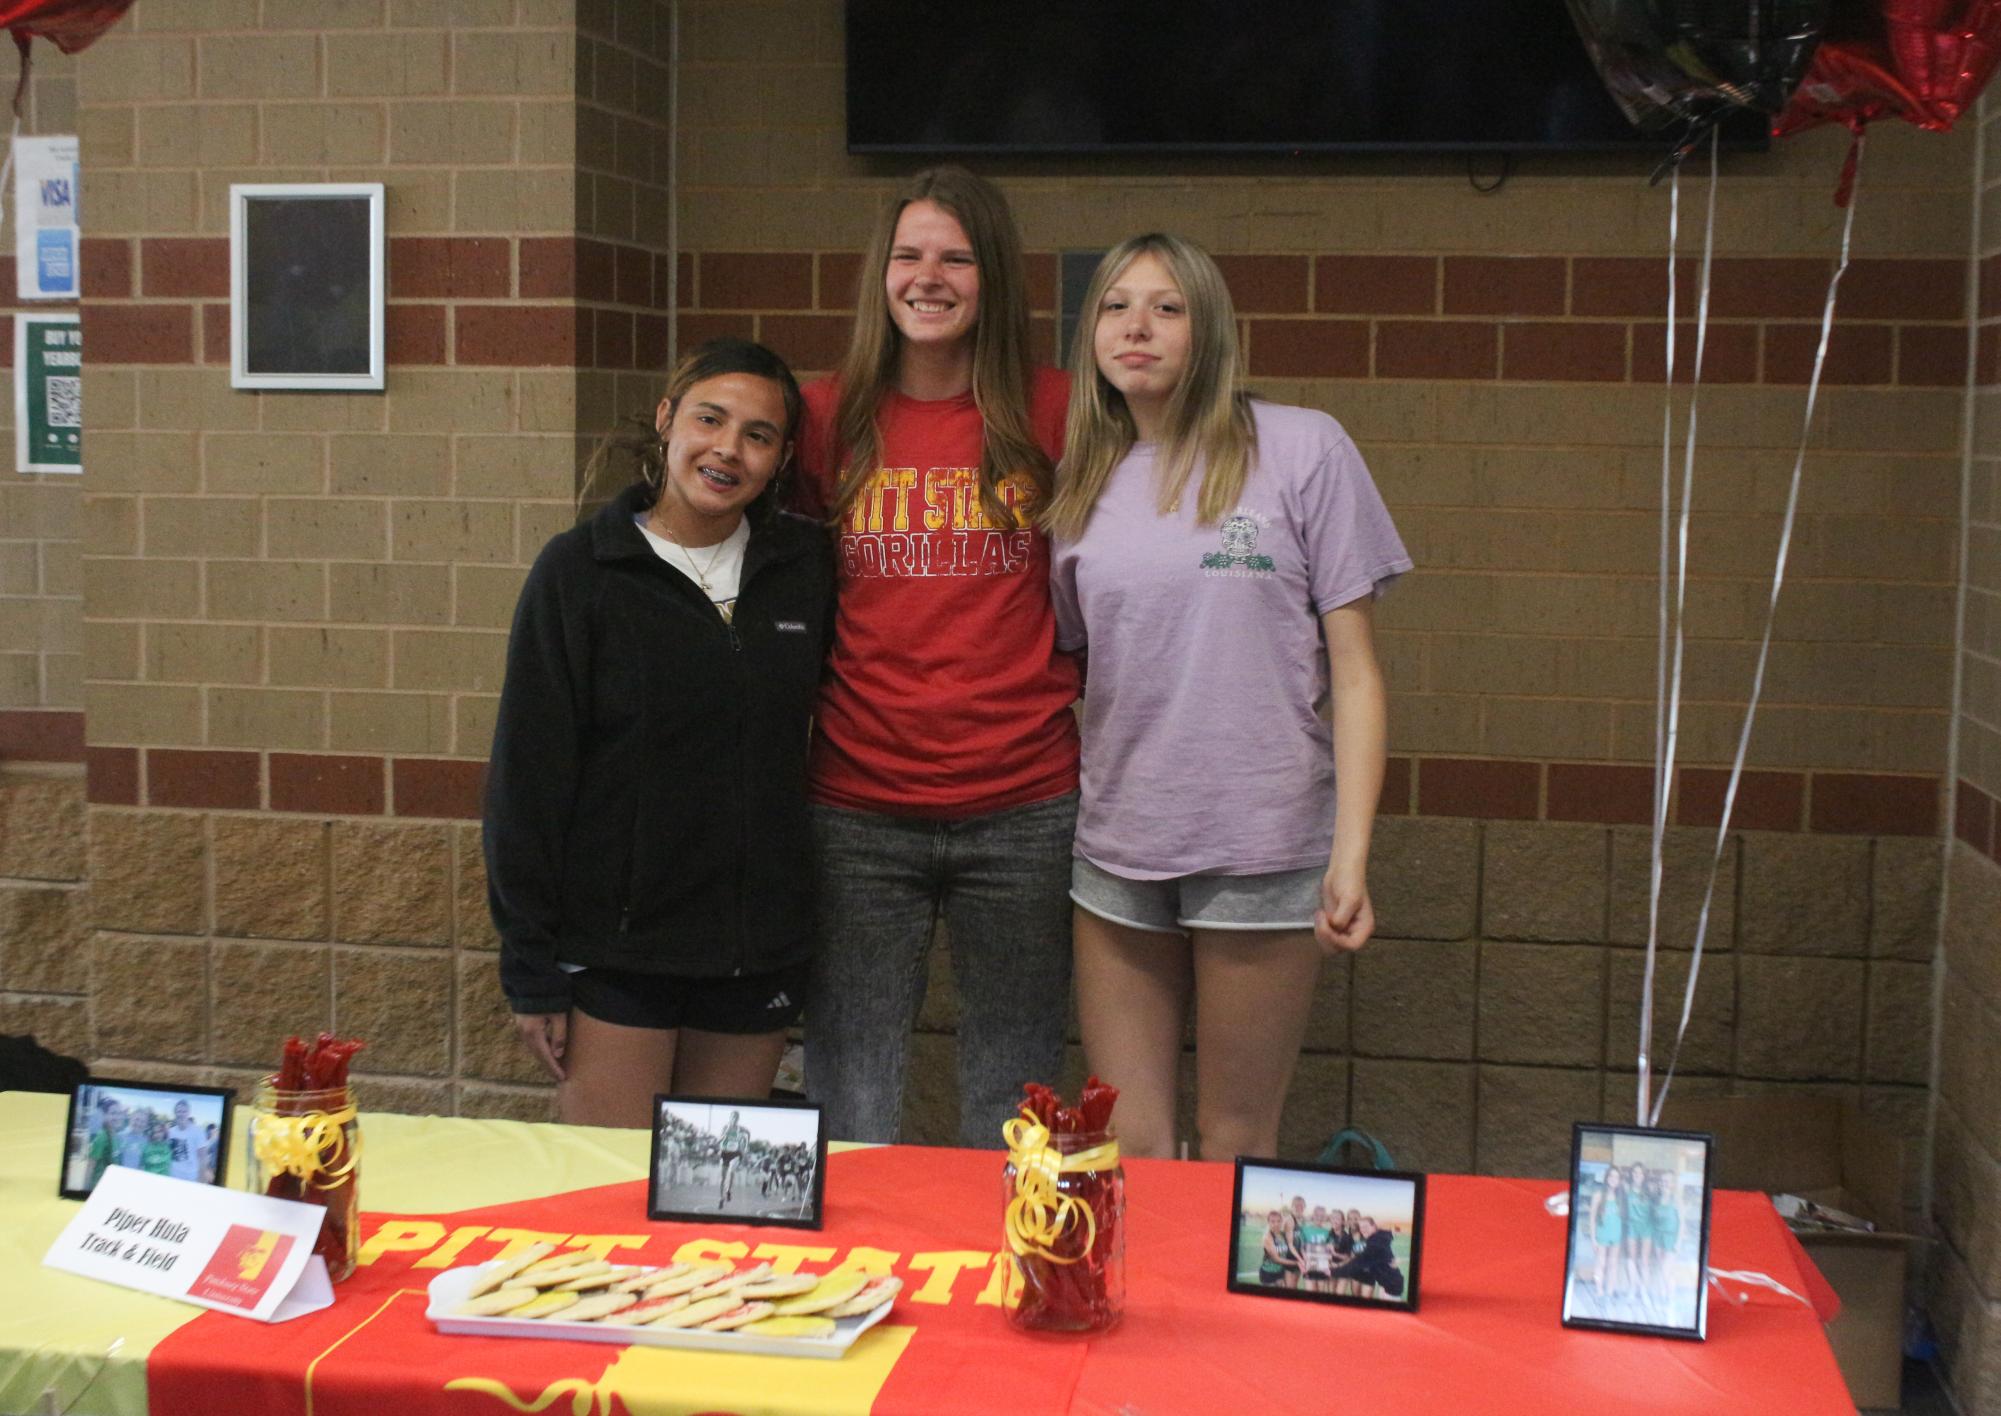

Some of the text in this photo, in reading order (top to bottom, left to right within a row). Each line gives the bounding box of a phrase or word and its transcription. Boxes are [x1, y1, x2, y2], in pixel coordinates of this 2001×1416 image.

[39, 179, 71, 207] VISA
[840, 467, 918, 533] ITT
[840, 531, 1032, 578] GORILLAS
[103, 1206, 192, 1244] Piper Hula
[356, 1219, 652, 1270] PITT
[80, 1231, 181, 1273] Track & Field
